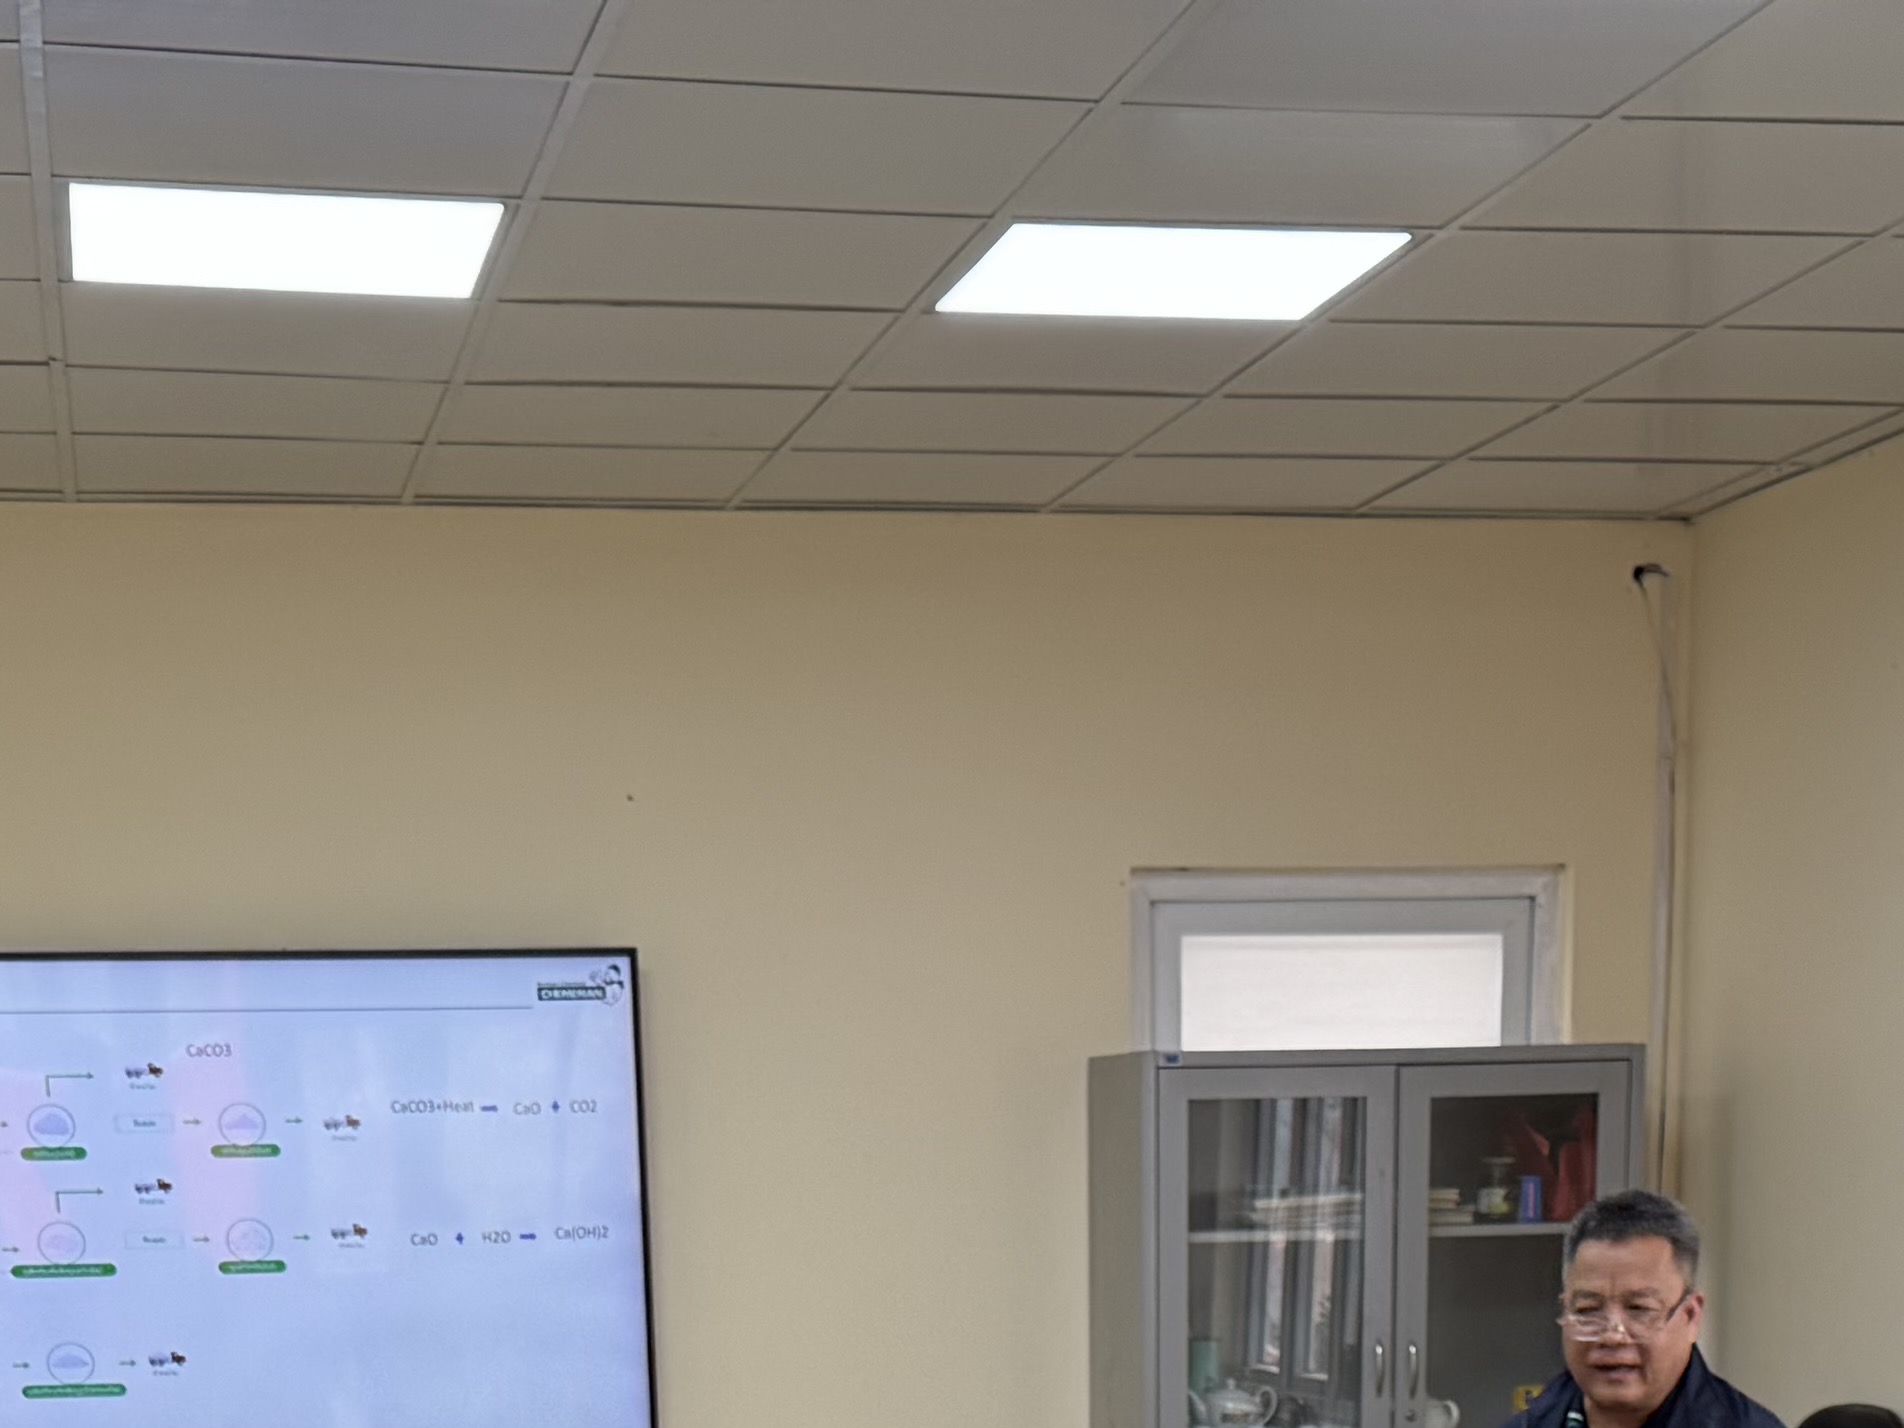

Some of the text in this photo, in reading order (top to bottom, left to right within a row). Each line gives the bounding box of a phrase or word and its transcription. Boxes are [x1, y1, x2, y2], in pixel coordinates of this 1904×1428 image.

[186, 1043, 232, 1058] CaCO3
[513, 1102, 541, 1115] CaO
[569, 1100, 598, 1113] CO2
[410, 1226, 609, 1246] CaO H2O Ca(OH)2
